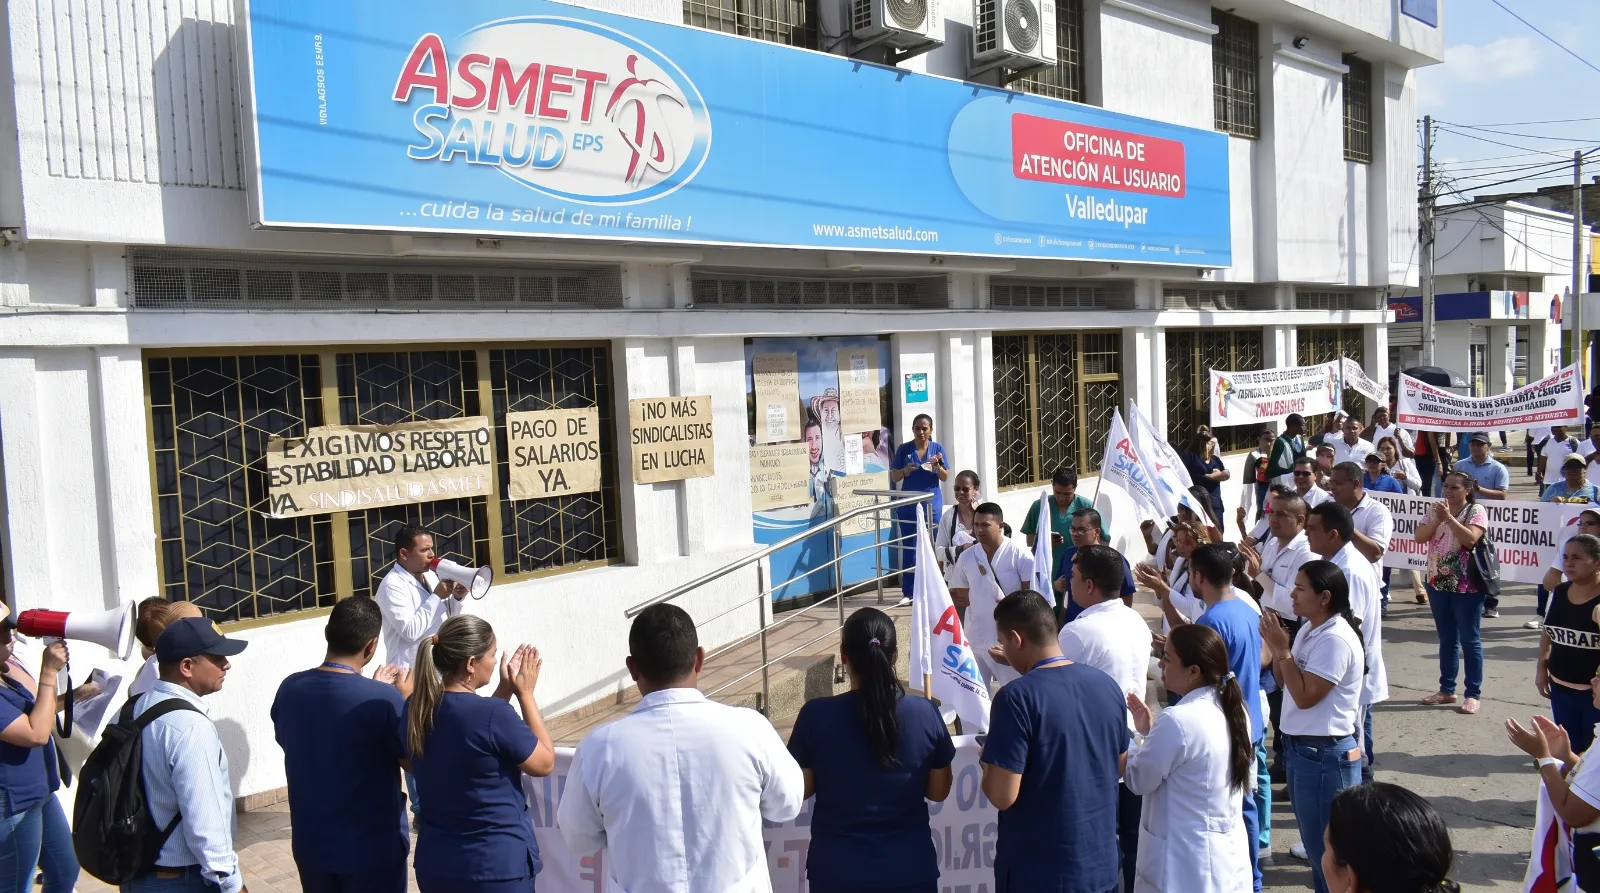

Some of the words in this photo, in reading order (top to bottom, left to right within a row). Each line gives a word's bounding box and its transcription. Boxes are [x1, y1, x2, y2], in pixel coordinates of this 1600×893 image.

[392, 33, 609, 123] ASMET
[407, 104, 567, 169] SALUD
[572, 133, 604, 152] EPS
[1063, 130, 1124, 158] OFICINA
[1126, 142, 1146, 162] DE
[1020, 153, 1099, 182] ATENCIÓN
[1102, 165, 1121, 185] AL
[1123, 167, 1181, 193] USUARIO
[485, 203, 505, 221] la
[510, 208, 566, 226] salud
[570, 211, 594, 227] de
[598, 211, 621, 229] mi
[624, 211, 682, 231] familia
[1065, 193, 1148, 228] Valledupar
[812, 222, 939, 243] www.asmetsalud.com
[671, 396, 698, 418] MÁS
[282, 431, 406, 459] EXIGIMOS
[410, 426, 490, 452] RESPETO
[511, 419, 558, 440] PAGO
[566, 417, 589, 437] DE
[632, 422, 713, 445] SINDICALISTAS
[403, 447, 491, 474] LABORAL
[514, 440, 599, 468] SALARIOS
[641, 452, 659, 471] EN
[664, 448, 706, 469] LUCHA
[308, 481, 424, 510] SINDISALUD
[427, 473, 484, 497] ASMET
[1522, 508, 1539, 525] DE
[1496, 548, 1539, 568] LUCHA
